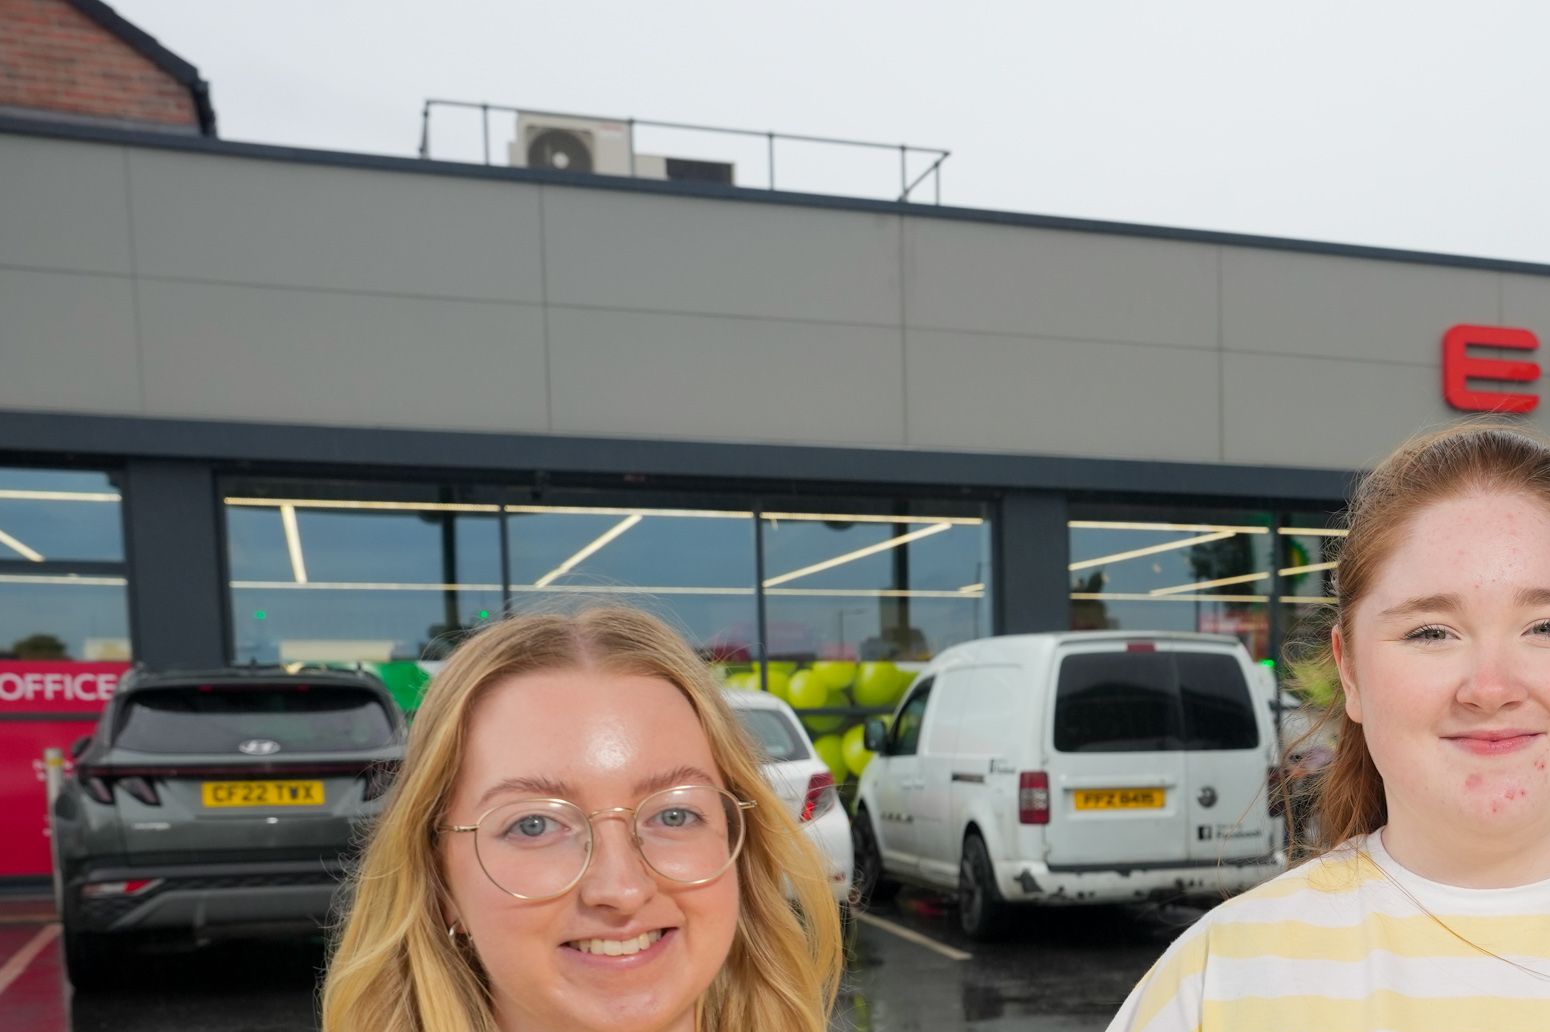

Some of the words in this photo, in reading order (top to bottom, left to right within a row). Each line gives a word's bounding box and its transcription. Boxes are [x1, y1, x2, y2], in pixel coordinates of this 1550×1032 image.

[0, 672, 117, 701] OFFICE
[212, 784, 268, 802] CF22
[275, 783, 314, 800] TWX
